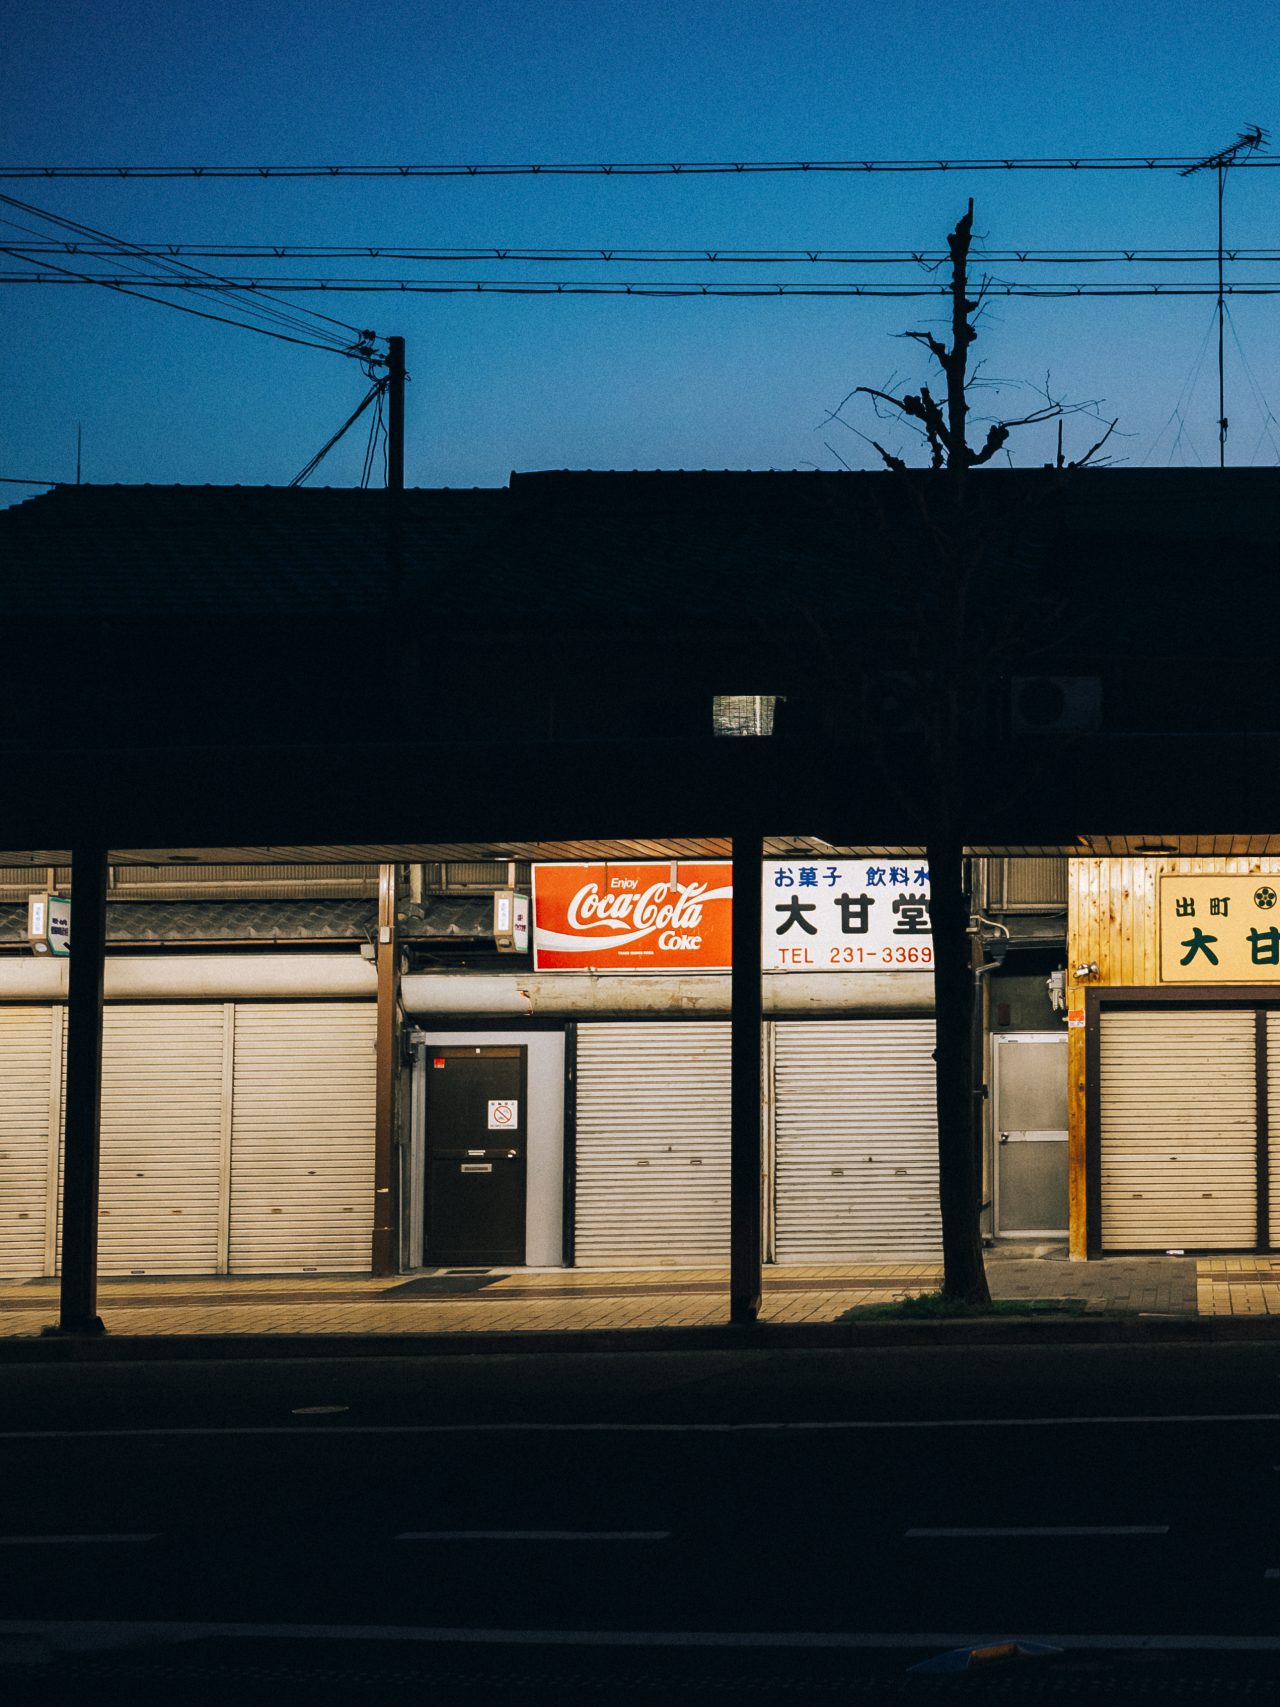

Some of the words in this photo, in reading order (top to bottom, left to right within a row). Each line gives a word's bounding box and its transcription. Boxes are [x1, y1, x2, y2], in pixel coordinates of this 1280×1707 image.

[611, 878, 639, 890] Enjoy
[774, 866, 842, 887] お菓子
[866, 866, 930, 887] 飲料水
[567, 882, 708, 930] Coca-Cola
[775, 892, 932, 936] 大甘堂
[1176, 896, 1231, 917] 出町
[658, 931, 703, 950] Coke
[778, 948, 814, 964] TEL
[830, 947, 932, 964] 231-3369
